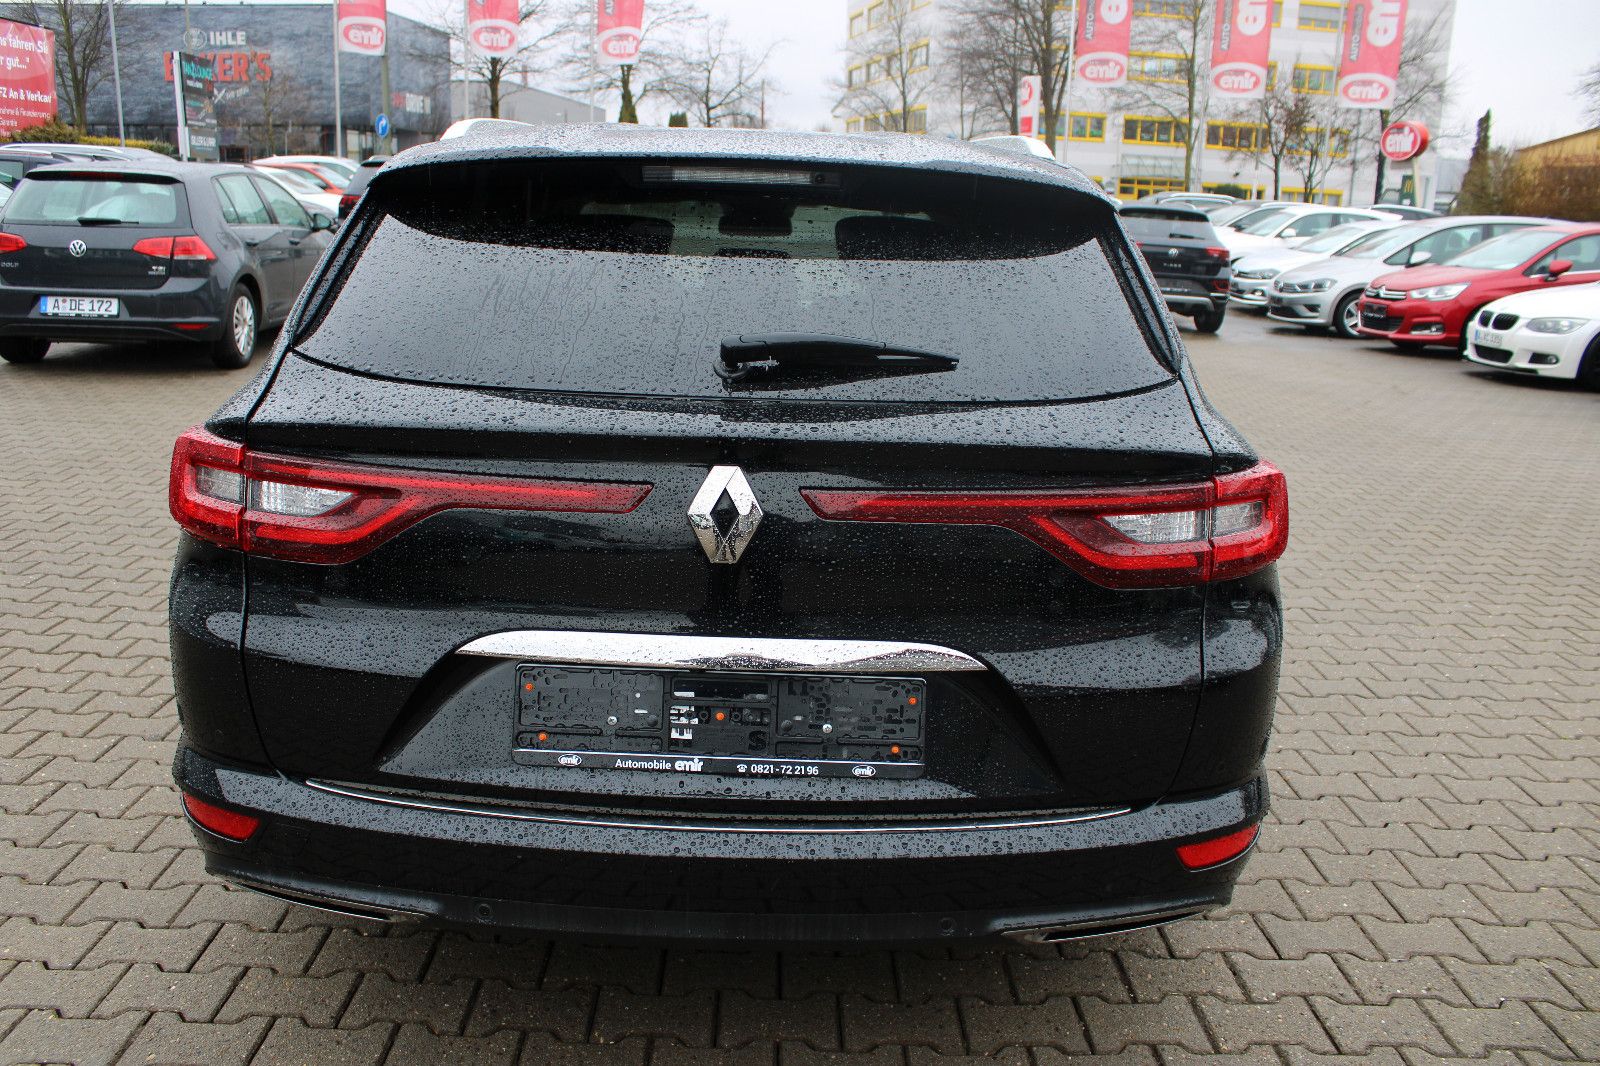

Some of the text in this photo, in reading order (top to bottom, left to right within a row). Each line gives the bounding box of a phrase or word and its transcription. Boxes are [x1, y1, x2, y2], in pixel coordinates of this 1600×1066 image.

[209, 31, 247, 46] IHLE
[348, 27, 383, 46] emir
[479, 29, 511, 48] emir
[163, 49, 272, 82] BKER'S
[1085, 61, 1121, 80] emir
[1219, 71, 1257, 90] emir
[1347, 82, 1385, 101] emir
[1386, 126, 1415, 153] emir
[88, 299, 113, 313] 172
[560, 756, 579, 766] emir
[614, 757, 704, 772] Automobile emir
[854, 766, 873, 776] emir
